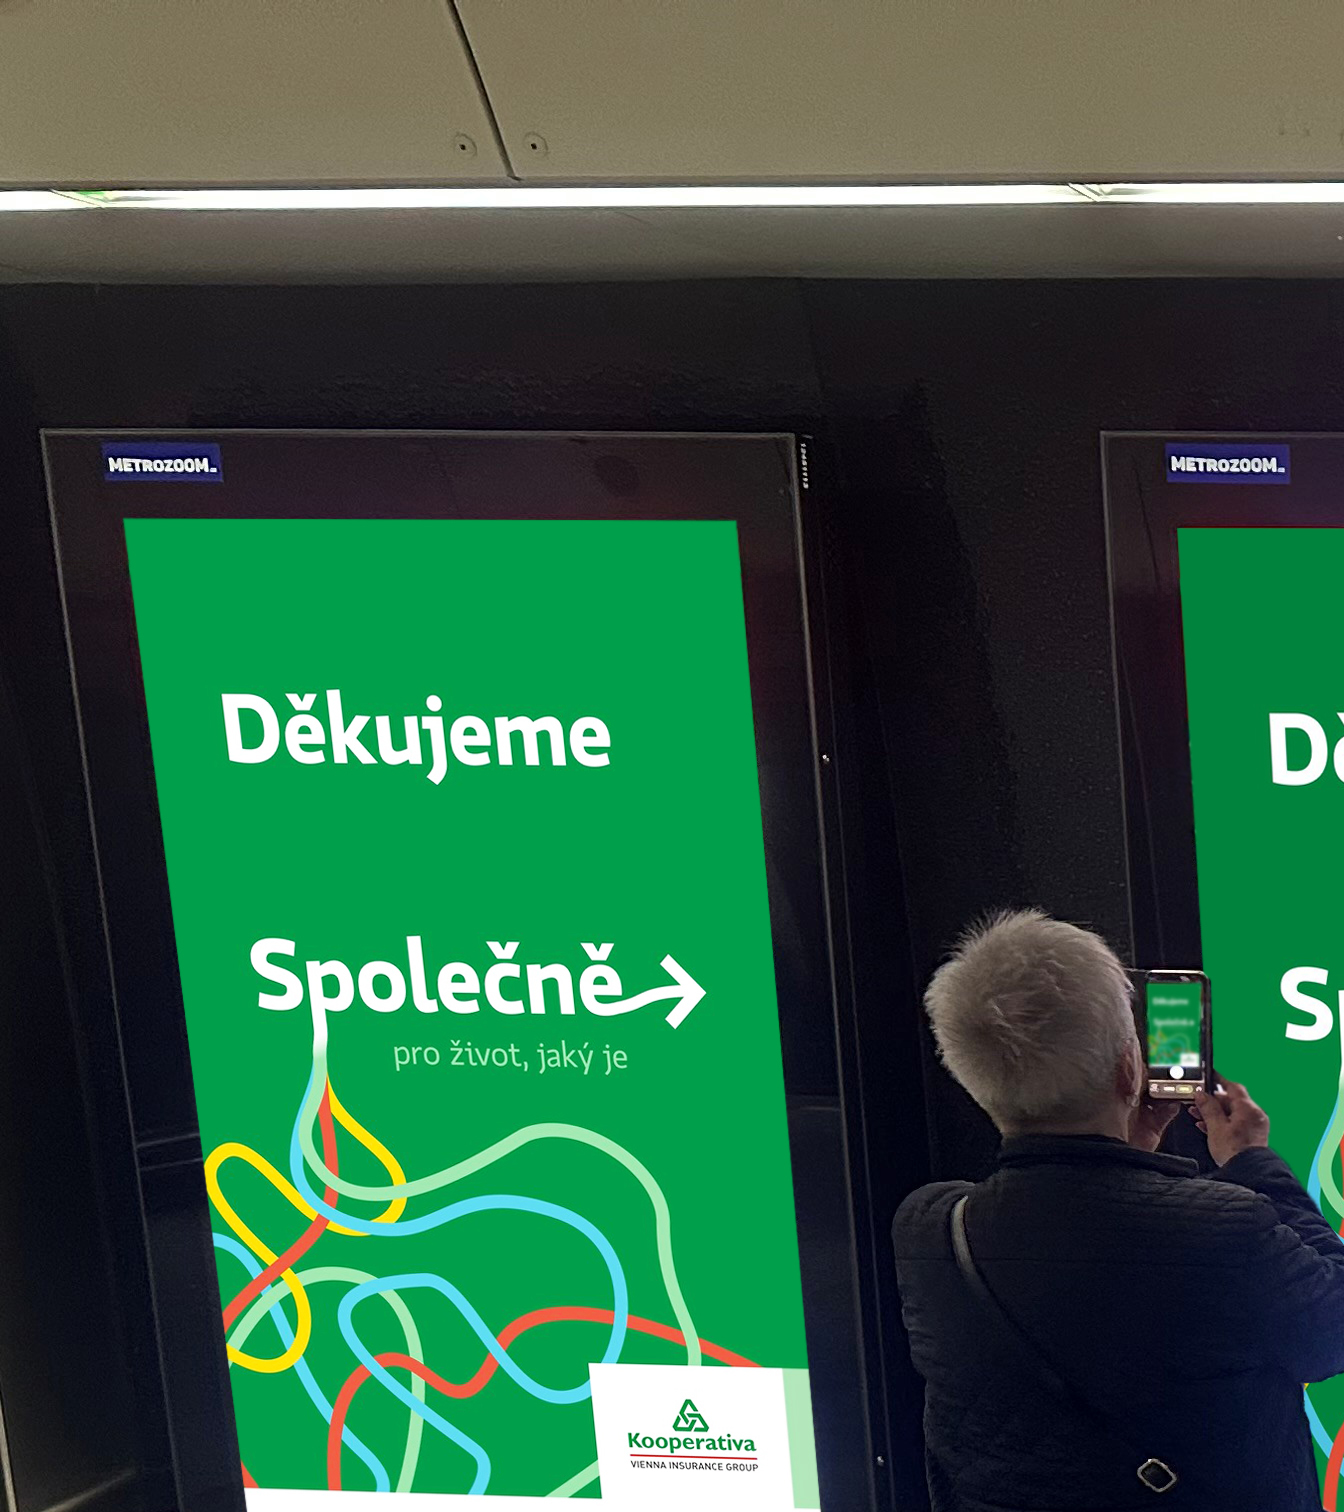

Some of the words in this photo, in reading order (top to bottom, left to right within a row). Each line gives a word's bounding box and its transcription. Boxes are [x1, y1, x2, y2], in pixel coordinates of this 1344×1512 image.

[221, 688, 611, 786] Děkujeme
[249, 935, 624, 1052] Společně
[394, 1046, 440, 1072] pro
[450, 1039, 528, 1072] život,
[537, 1039, 594, 1075] jaký
[602, 1044, 628, 1075] je
[627, 1432, 757, 1454] Kooperativa
[630, 1460, 667, 1469] VIENNA
[669, 1461, 724, 1471] INSURANCE
[726, 1462, 759, 1472] GROUP
